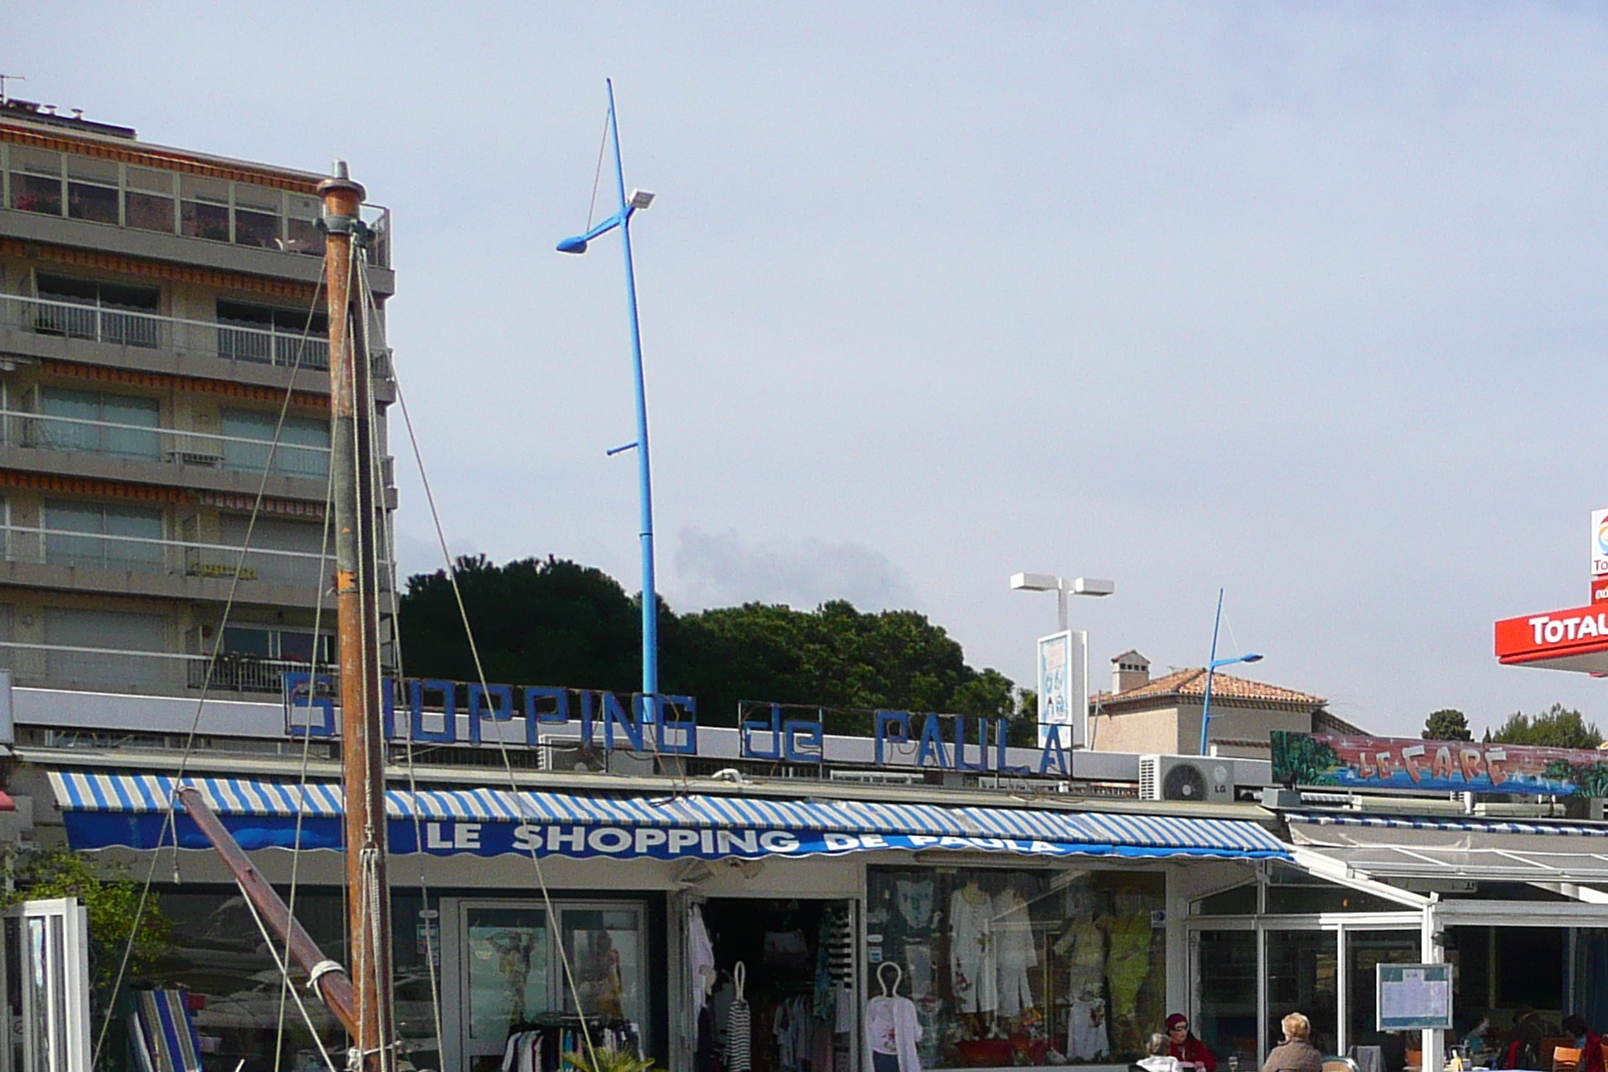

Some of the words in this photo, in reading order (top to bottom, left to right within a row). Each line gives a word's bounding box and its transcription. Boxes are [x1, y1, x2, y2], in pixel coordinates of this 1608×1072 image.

[875, 710, 1070, 776] PAULA
[1359, 751, 1394, 780] LE
[426, 823, 481, 848] LE
[513, 825, 800, 854] SHOPPING
[825, 833, 892, 852] DE
[914, 835, 1065, 853] PAULA
